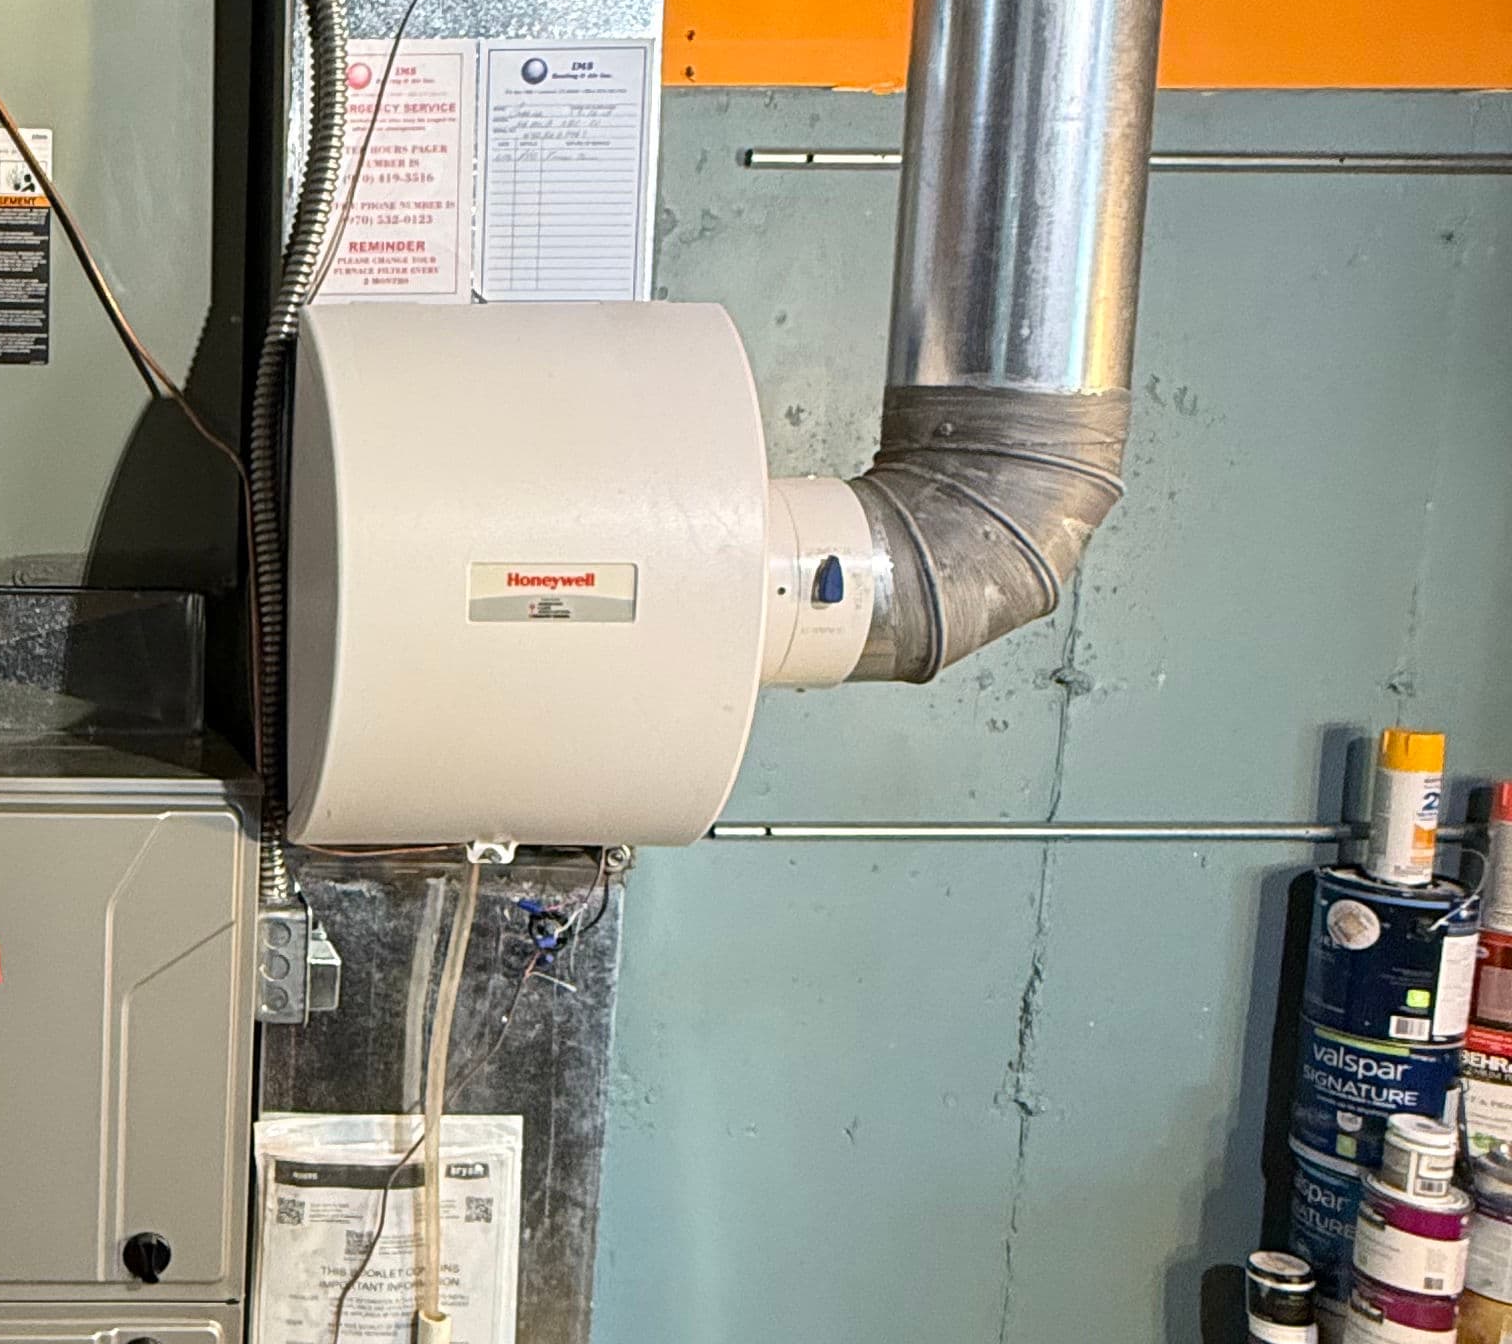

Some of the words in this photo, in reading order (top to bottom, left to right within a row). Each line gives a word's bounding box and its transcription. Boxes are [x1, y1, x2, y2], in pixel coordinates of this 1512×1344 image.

[349, 103, 400, 113] RGECY
[403, 102, 456, 113] SERVICE
[366, 159, 405, 168] UMBER
[348, 241, 426, 253] REMINDER
[507, 573, 595, 590] Honeywell
[1312, 1042, 1414, 1082] valspar
[1302, 1064, 1420, 1106] SIGNATURE
[320, 1266, 347, 1277] THIS
[349, 1266, 404, 1279] BOKLET
[319, 1280, 383, 1292] IMPOTANT
